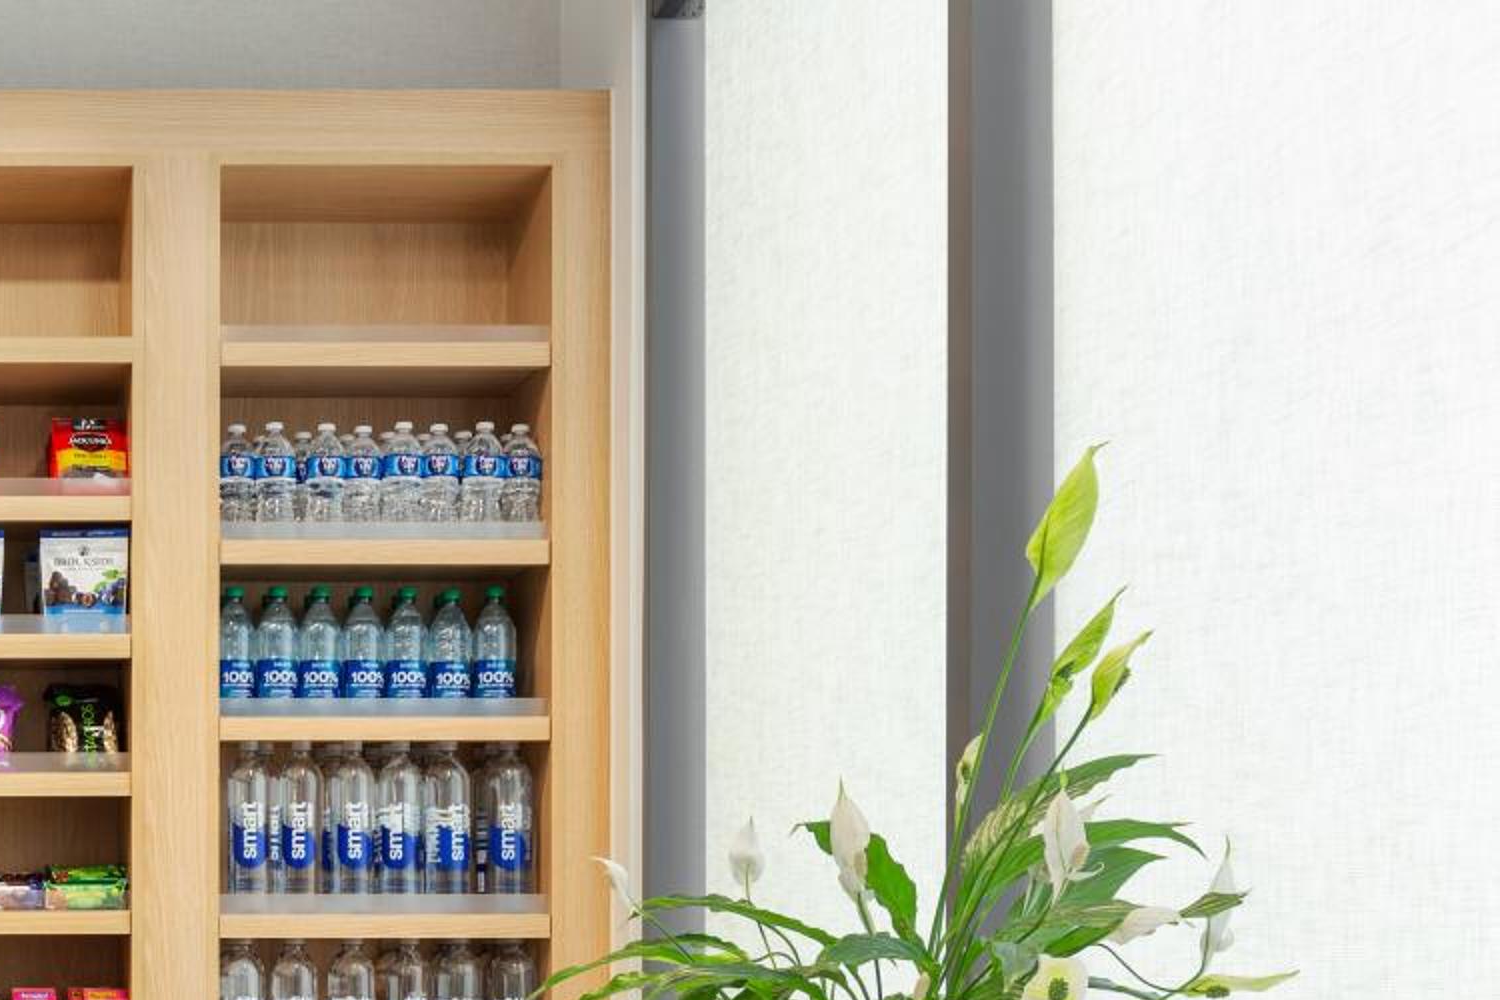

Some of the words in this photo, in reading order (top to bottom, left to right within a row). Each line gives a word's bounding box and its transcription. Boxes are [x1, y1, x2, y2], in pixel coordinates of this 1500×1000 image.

[242, 801, 258, 860] smart
[291, 801, 307, 860] smart
[349, 801, 364, 860] smart
[388, 801, 404, 861] smart
[451, 802, 466, 862] smart
[501, 801, 516, 861] smart
